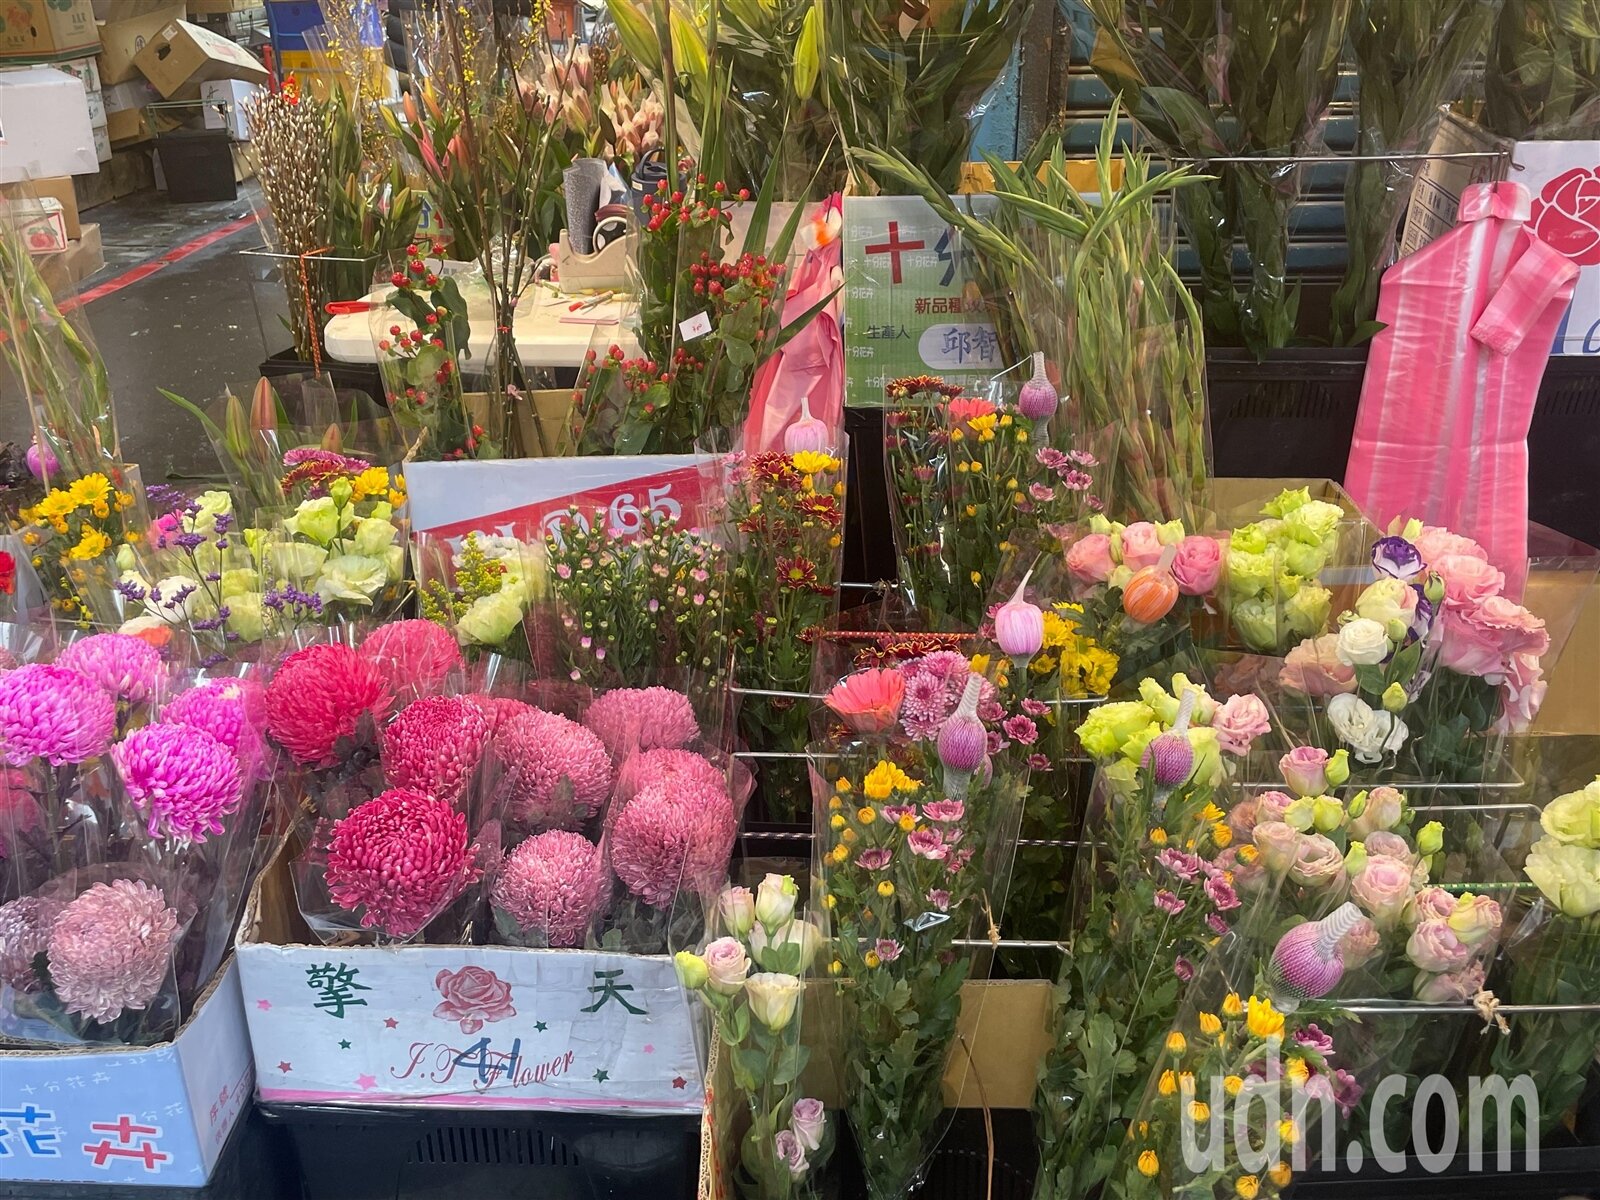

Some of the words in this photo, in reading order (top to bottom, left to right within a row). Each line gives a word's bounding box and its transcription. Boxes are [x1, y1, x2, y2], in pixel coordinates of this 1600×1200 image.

[867, 325, 910, 340] 生產人
[611, 483, 681, 534] 65
[580, 968, 649, 1014] 天
